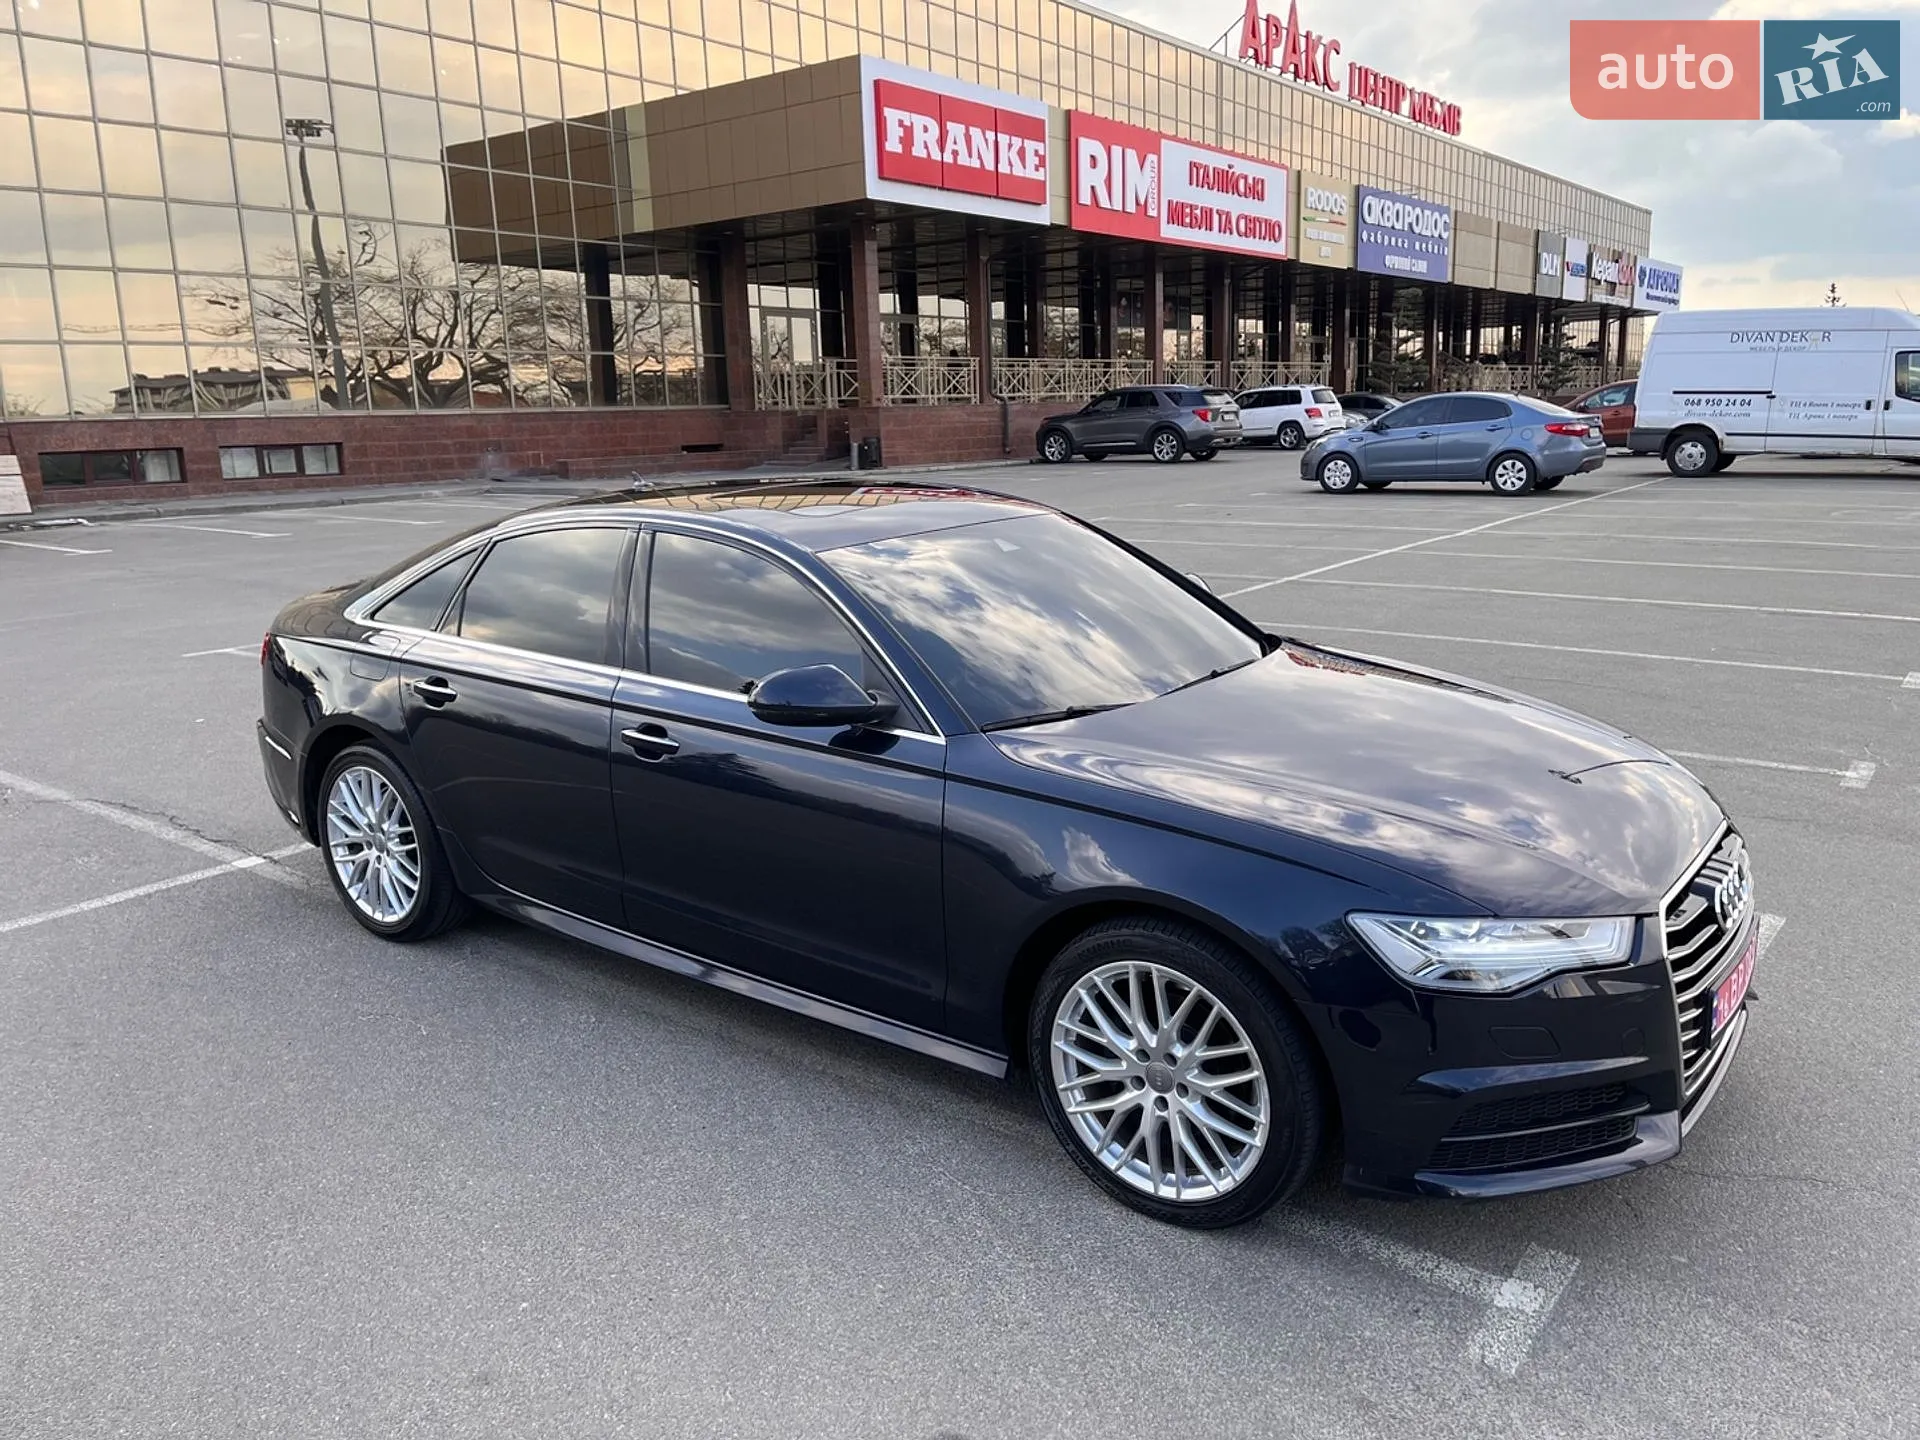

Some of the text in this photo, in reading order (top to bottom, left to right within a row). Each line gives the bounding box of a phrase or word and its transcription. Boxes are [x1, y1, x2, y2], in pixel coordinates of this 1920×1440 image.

[1239, 0, 1462, 136] АРАКС ЦЕНТР МЕБЛІВ
[882, 106, 1046, 182] FRANKE
[1077, 136, 1159, 217] RIM
[1189, 162, 1265, 202] ІТАЛІЙСЬКІ
[1167, 199, 1214, 232] МЕБЛІ
[1216, 209, 1234, 236] ТА
[1235, 213, 1283, 243] СВІТЛО
[1305, 187, 1347, 216] RODOS
[1361, 229, 1409, 249] фабрика
[1414, 237, 1449, 256] меблів
[1730, 331, 1775, 344] DIVAN
[1684, 398, 1752, 407] 068 950 24 04
